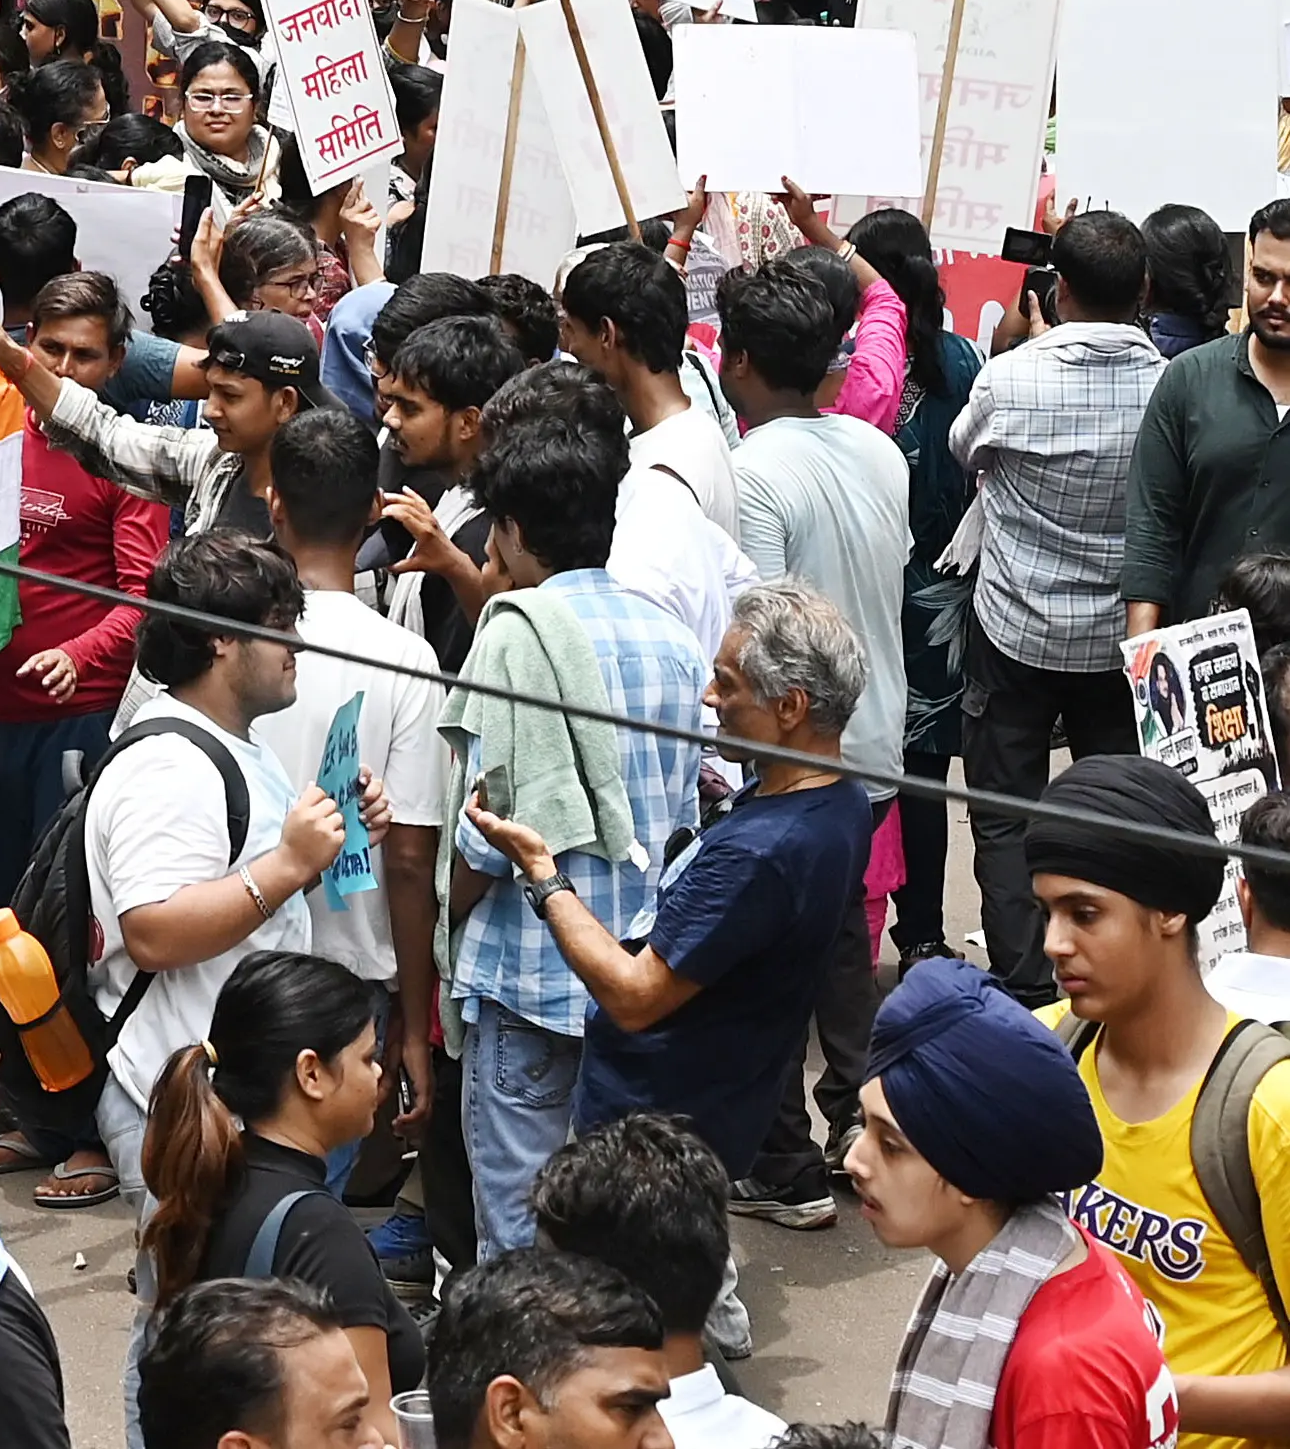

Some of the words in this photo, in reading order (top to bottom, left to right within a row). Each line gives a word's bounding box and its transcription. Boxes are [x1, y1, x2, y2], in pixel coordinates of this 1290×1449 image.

[301, 51, 368, 101] महिला
[315, 104, 383, 164] समिति
[1205, 703, 1245, 745] शिक्षा
[1058, 1180, 1208, 1282] KERS
